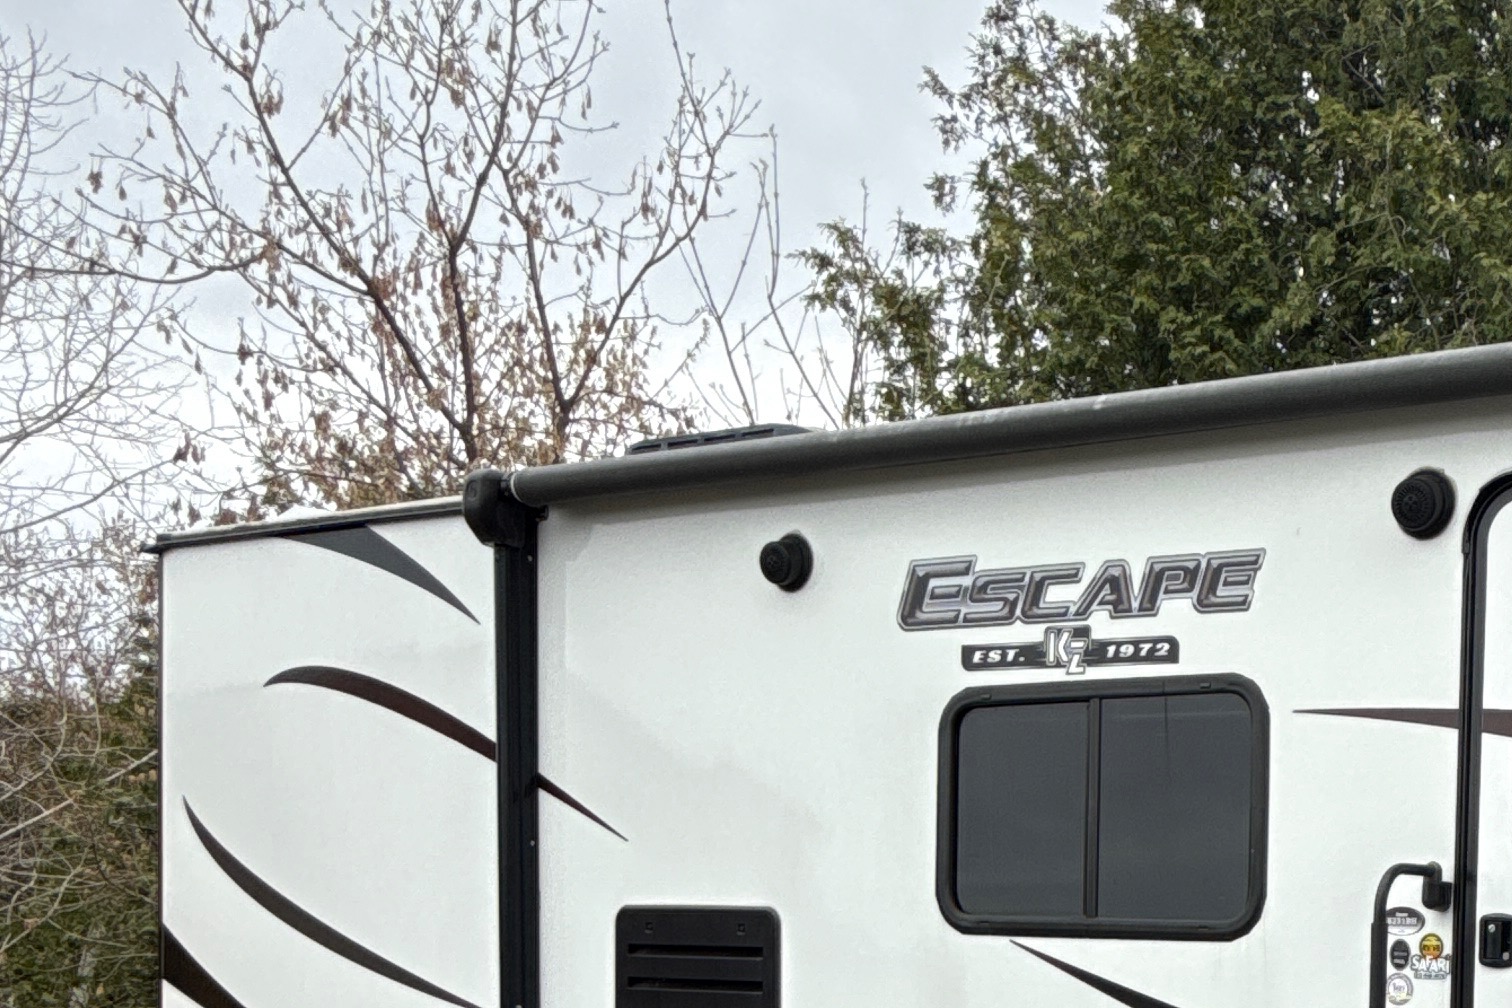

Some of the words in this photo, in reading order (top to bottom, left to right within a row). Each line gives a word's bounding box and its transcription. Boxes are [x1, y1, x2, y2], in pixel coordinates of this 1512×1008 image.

[897, 547, 1267, 632] ESCAPE
[972, 648, 1026, 664] EST.
[1106, 642, 1171, 659] 1972
[1410, 953, 1451, 975] SAFARI
